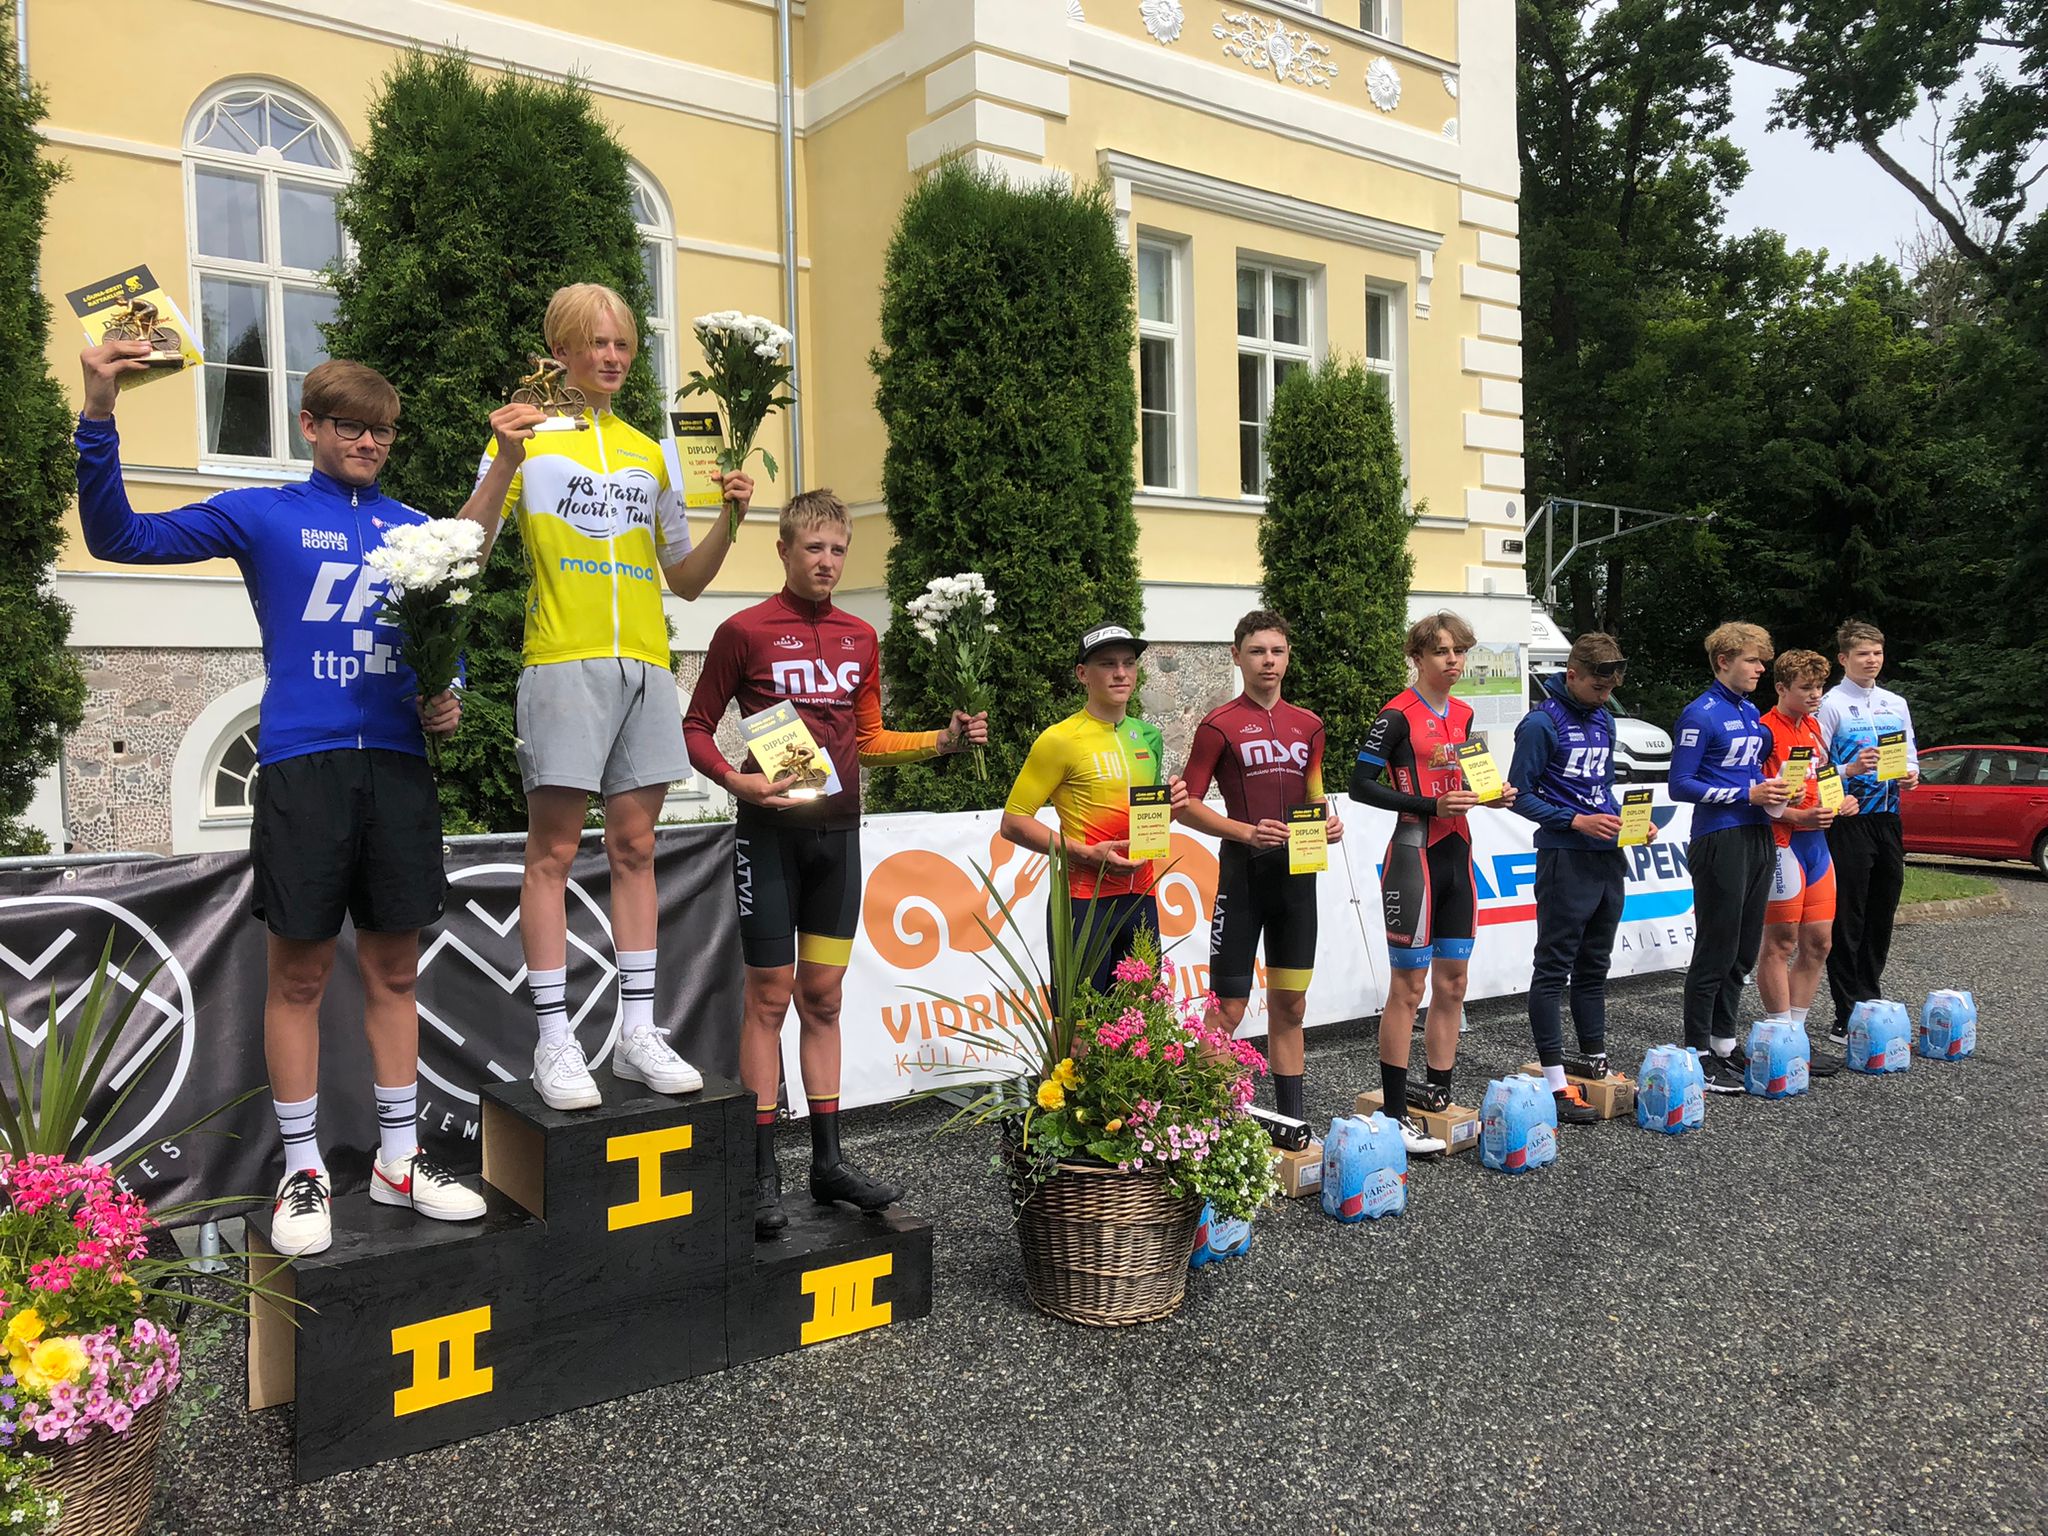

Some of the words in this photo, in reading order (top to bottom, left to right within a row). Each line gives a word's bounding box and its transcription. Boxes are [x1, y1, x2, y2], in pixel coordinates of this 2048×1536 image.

[687, 446, 717, 455] DIPLOM
[566, 476, 598, 500] 48.
[301, 528, 347, 542] RÄNNA
[302, 539, 348, 551] ROOTSI
[312, 650, 360, 688] ttp
[763, 731, 798, 752] DIPLOM
[1137, 812, 1162, 820] DIPLOM
[1295, 829, 1320, 837] DIPLOM
[735, 838, 754, 917] LATVIA
[1386, 890, 1402, 927] RRS
[1210, 894, 1228, 956] LATVIA
[800, 1252, 894, 1346] III
[391, 1305, 493, 1417] II
